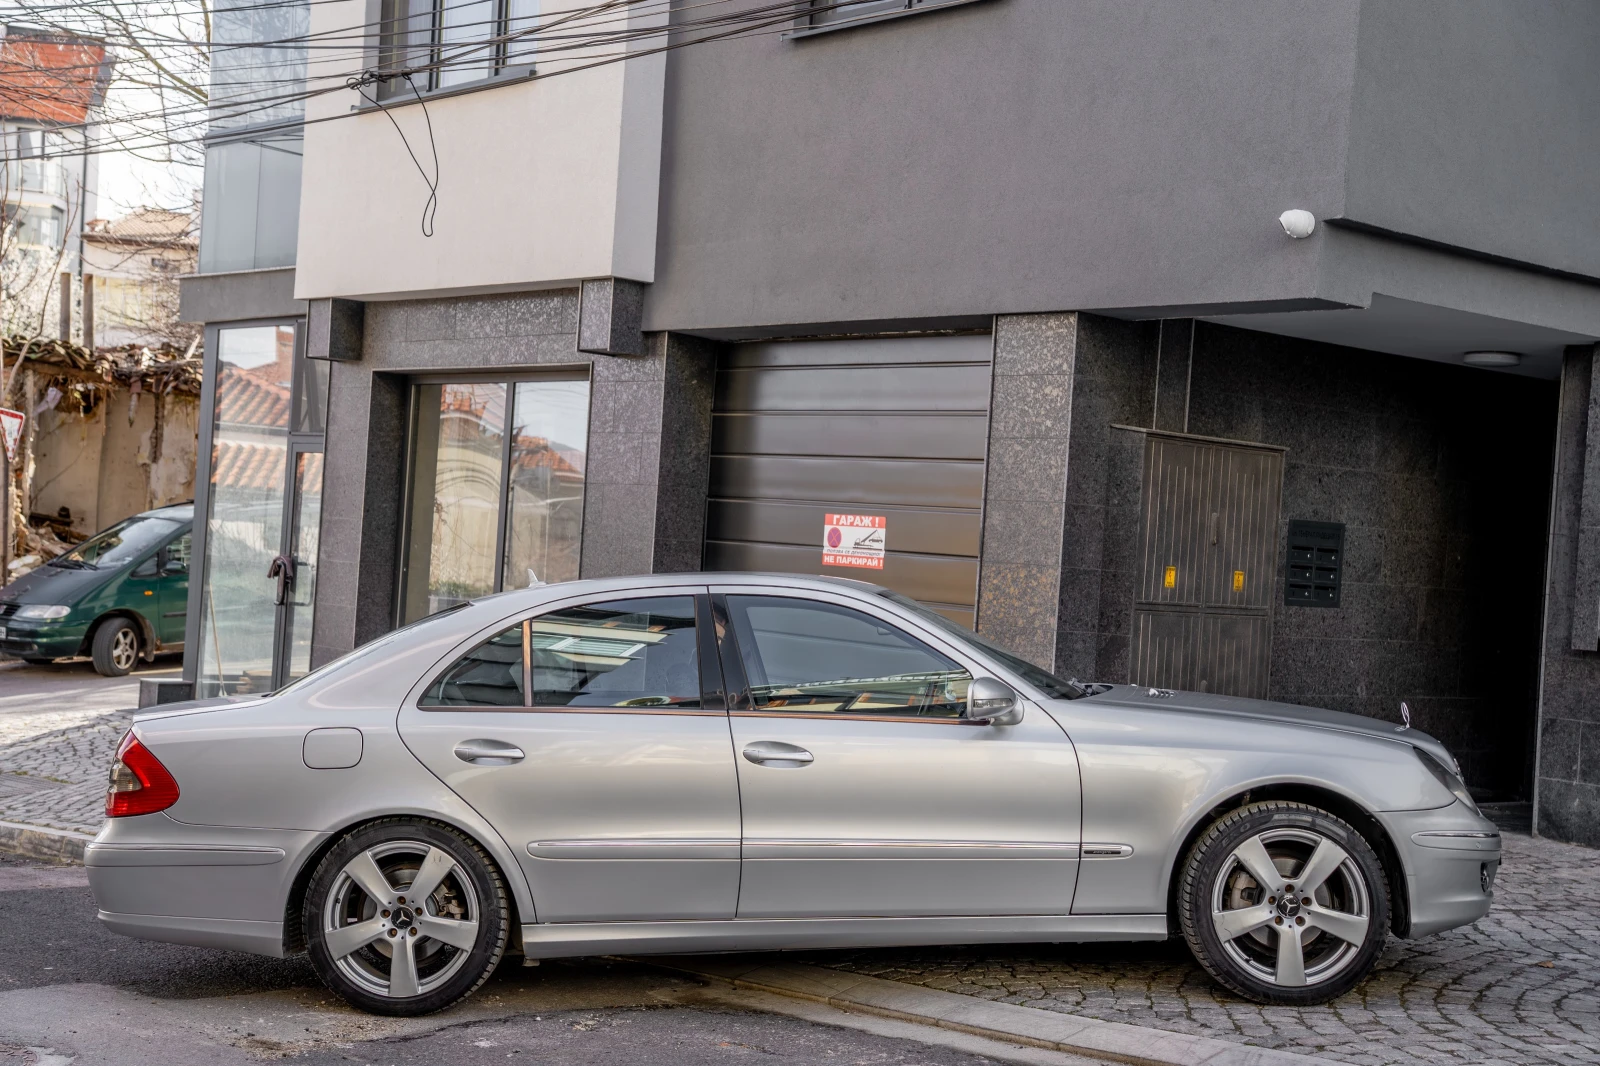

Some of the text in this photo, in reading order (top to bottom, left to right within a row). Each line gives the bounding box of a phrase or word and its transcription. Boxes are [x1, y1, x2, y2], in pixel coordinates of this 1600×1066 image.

[833, 515, 879, 527] ГАРАЖ !
[824, 555, 834, 563] НЕ
[836, 556, 878, 566] ПАРКИРАЙ
